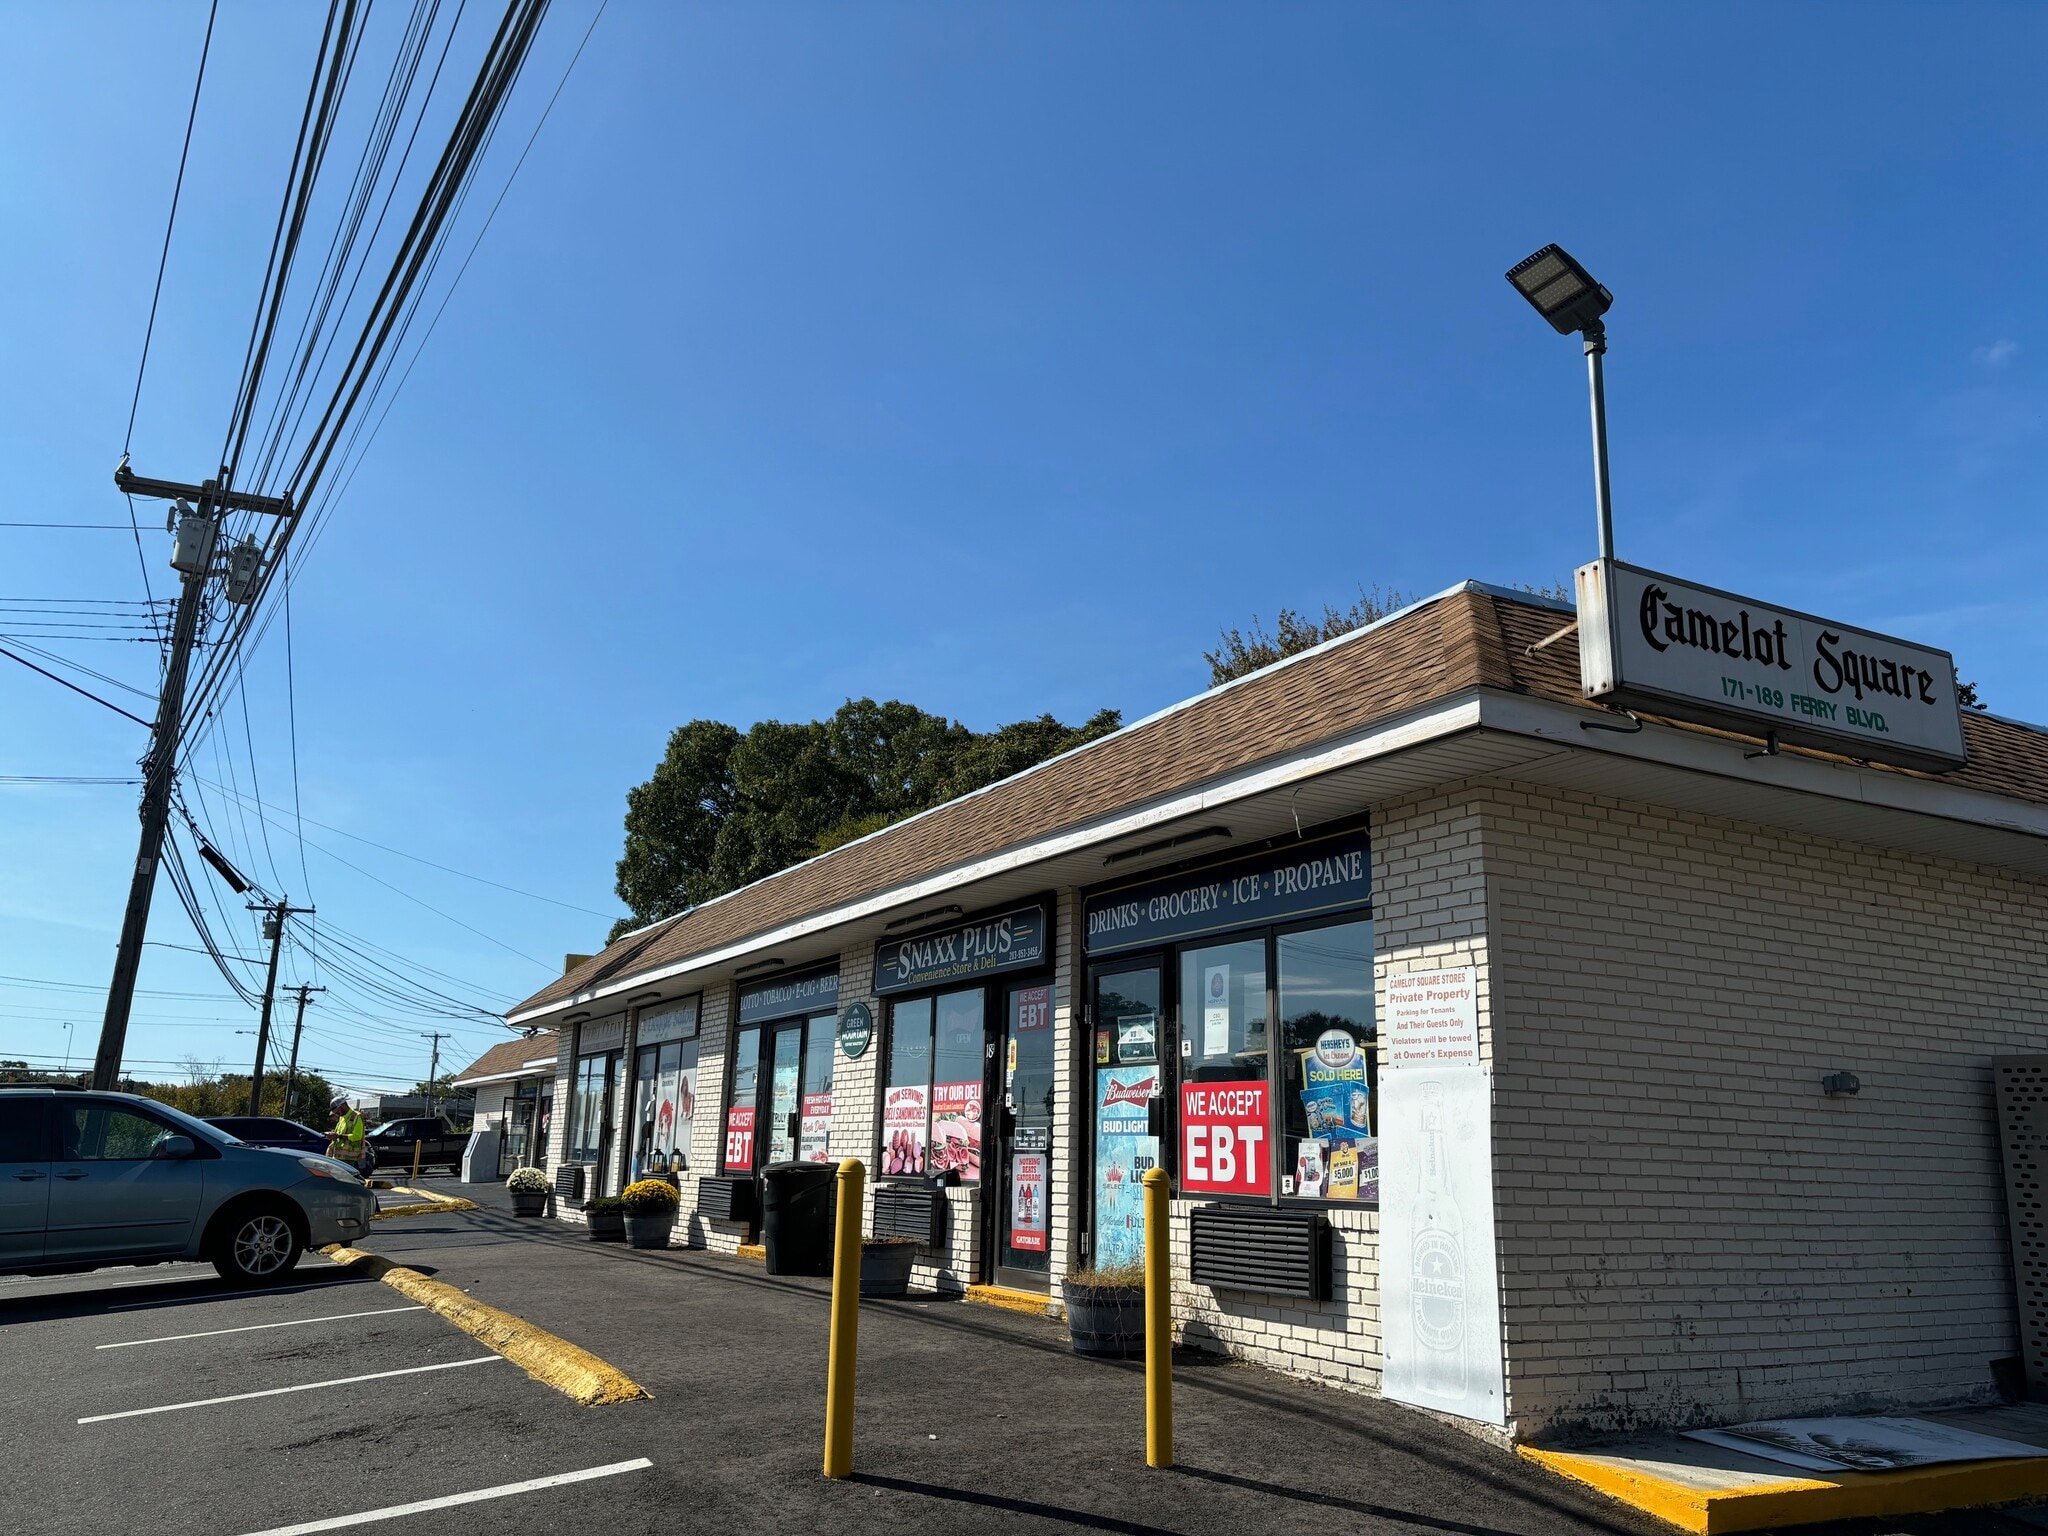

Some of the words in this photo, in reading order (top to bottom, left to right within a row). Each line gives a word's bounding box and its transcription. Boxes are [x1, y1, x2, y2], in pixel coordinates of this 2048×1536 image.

[1639, 583, 1793, 671] Camelot
[1813, 629, 1937, 705] Square
[1721, 676, 1783, 708] 171-189
[1790, 693, 1837, 721] FERRY
[1846, 706, 1889, 733] BLVD.
[1088, 902, 1138, 935] DRINKS
[1149, 883, 1220, 922] GROCERY
[1232, 874, 1260, 905] ICE
[1273, 850, 1363, 896] PROPANE
[898, 934, 957, 980] SNAXX
[961, 917, 1012, 962] PLUS
[908, 967, 951, 985] Convenience
[952, 962, 971, 976] Store
[974, 958, 979, 971] &
[980, 954, 996, 969] Deli
[1390, 978, 1415, 989] CAMELOT
[1417, 975, 1440, 987] SQUARE
[1442, 973, 1466, 984] STORES
[740, 993, 759, 1011] LOTTO
[763, 985, 791, 1006] TOBACCO
[795, 980, 815, 999] E-CIG
[820, 974, 838, 993] BEER
[1028, 989, 1047, 1001] ACCEPT
[1390, 992, 1423, 1003] Private
[1426, 988, 1470, 1001] Property
[846, 1017, 864, 1028] GREEN
[1019, 1003, 1047, 1028] EBT
[1397, 1021, 1408, 1030] And
[1409, 1020, 1425, 1029] Their
[1426, 1020, 1448, 1028] Guests
[1449, 1018, 1464, 1028] Only
[1320, 1039, 1350, 1050] HERSHEY'S
[1391, 1037, 1421, 1045] Violators
[1424, 1035, 1436, 1043] will
[1449, 1034, 1472, 1042] towed
[1403, 1050, 1435, 1059] Owner's
[1437, 1049, 1473, 1059] Expense
[1310, 1070, 1335, 1082] SOLD
[1337, 1069, 1363, 1081] HERE!
[901, 1088, 924, 1105] SERVING
[934, 1086, 948, 1102] TRY
[949, 1085, 964, 1101] OUR
[965, 1084, 981, 1100] DELI
[1185, 1091, 1206, 1116] WE
[1208, 1090, 1262, 1116] ACCEPT
[736, 1112, 753, 1126] ACCEPT
[1103, 1120, 1122, 1133] BUD
[726, 1132, 752, 1164] EBT
[1186, 1125, 1264, 1184] EBT
[1134, 1156, 1155, 1170] BUD
[1334, 1167, 1354, 1179] $5,000
[1016, 1236, 1040, 1245] GATORADE
[1412, 1277, 1463, 1298] Heineken
